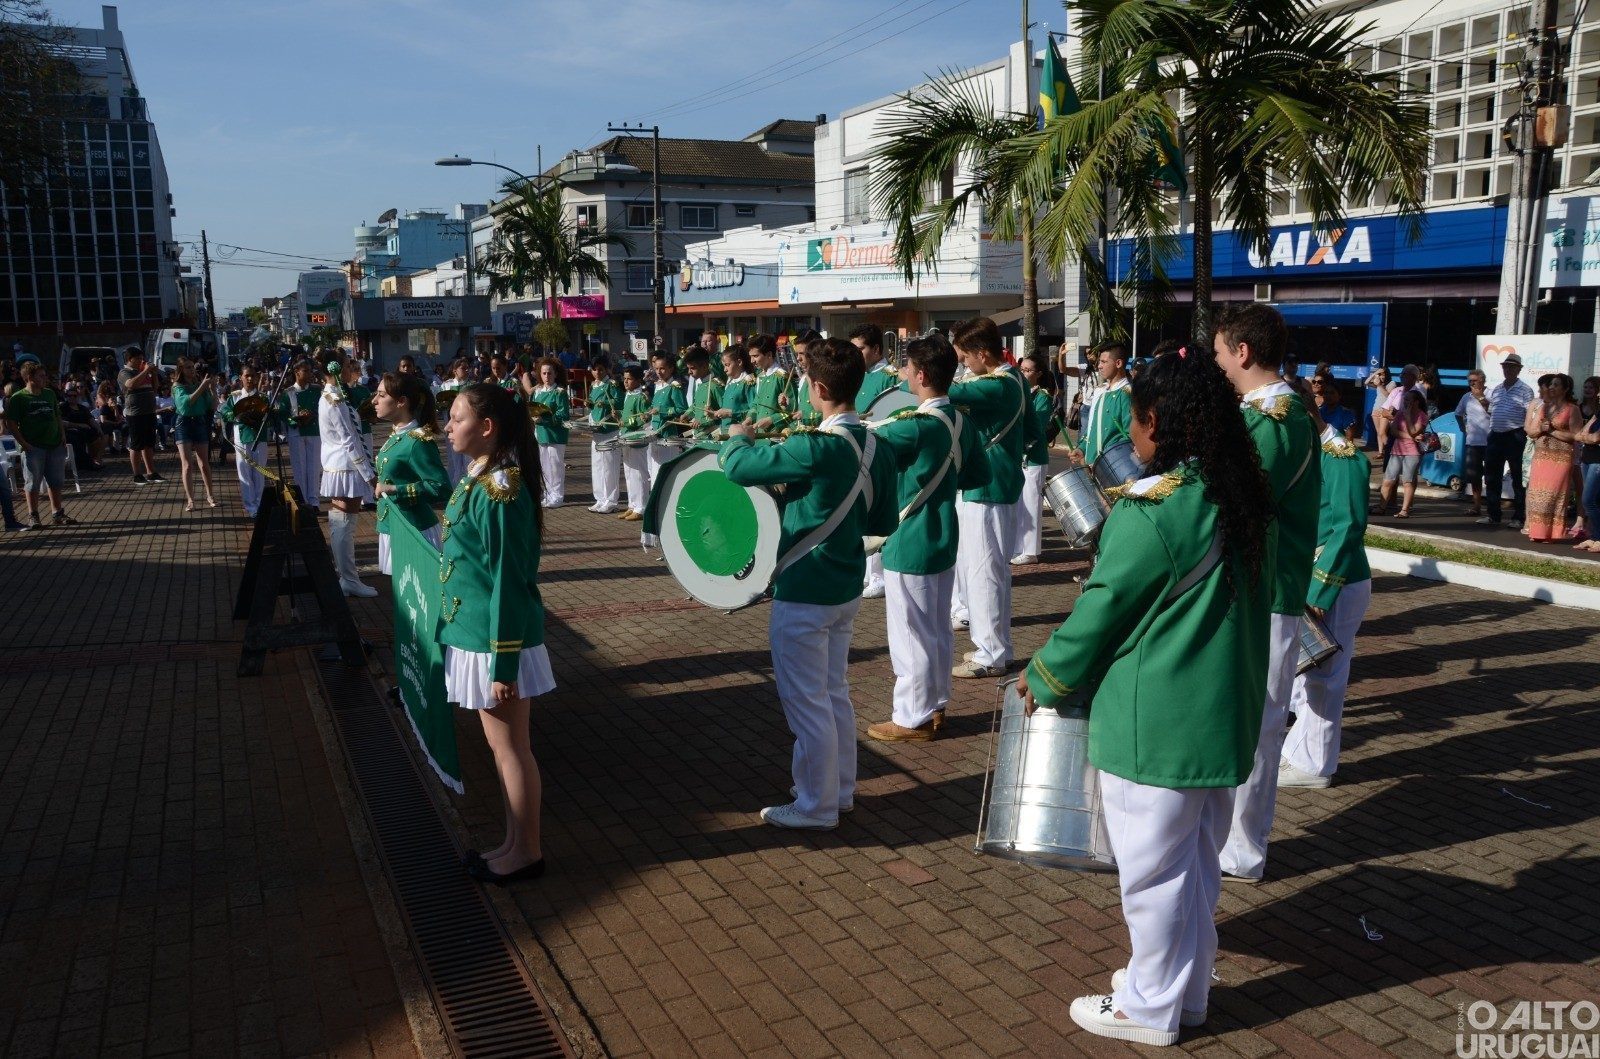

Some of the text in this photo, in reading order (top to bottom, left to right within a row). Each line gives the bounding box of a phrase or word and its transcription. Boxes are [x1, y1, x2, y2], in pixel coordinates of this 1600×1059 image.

[1248, 226, 1373, 269] CAIXA
[402, 302, 445, 310] BRIGADA
[404, 309, 444, 317] MILITAR
